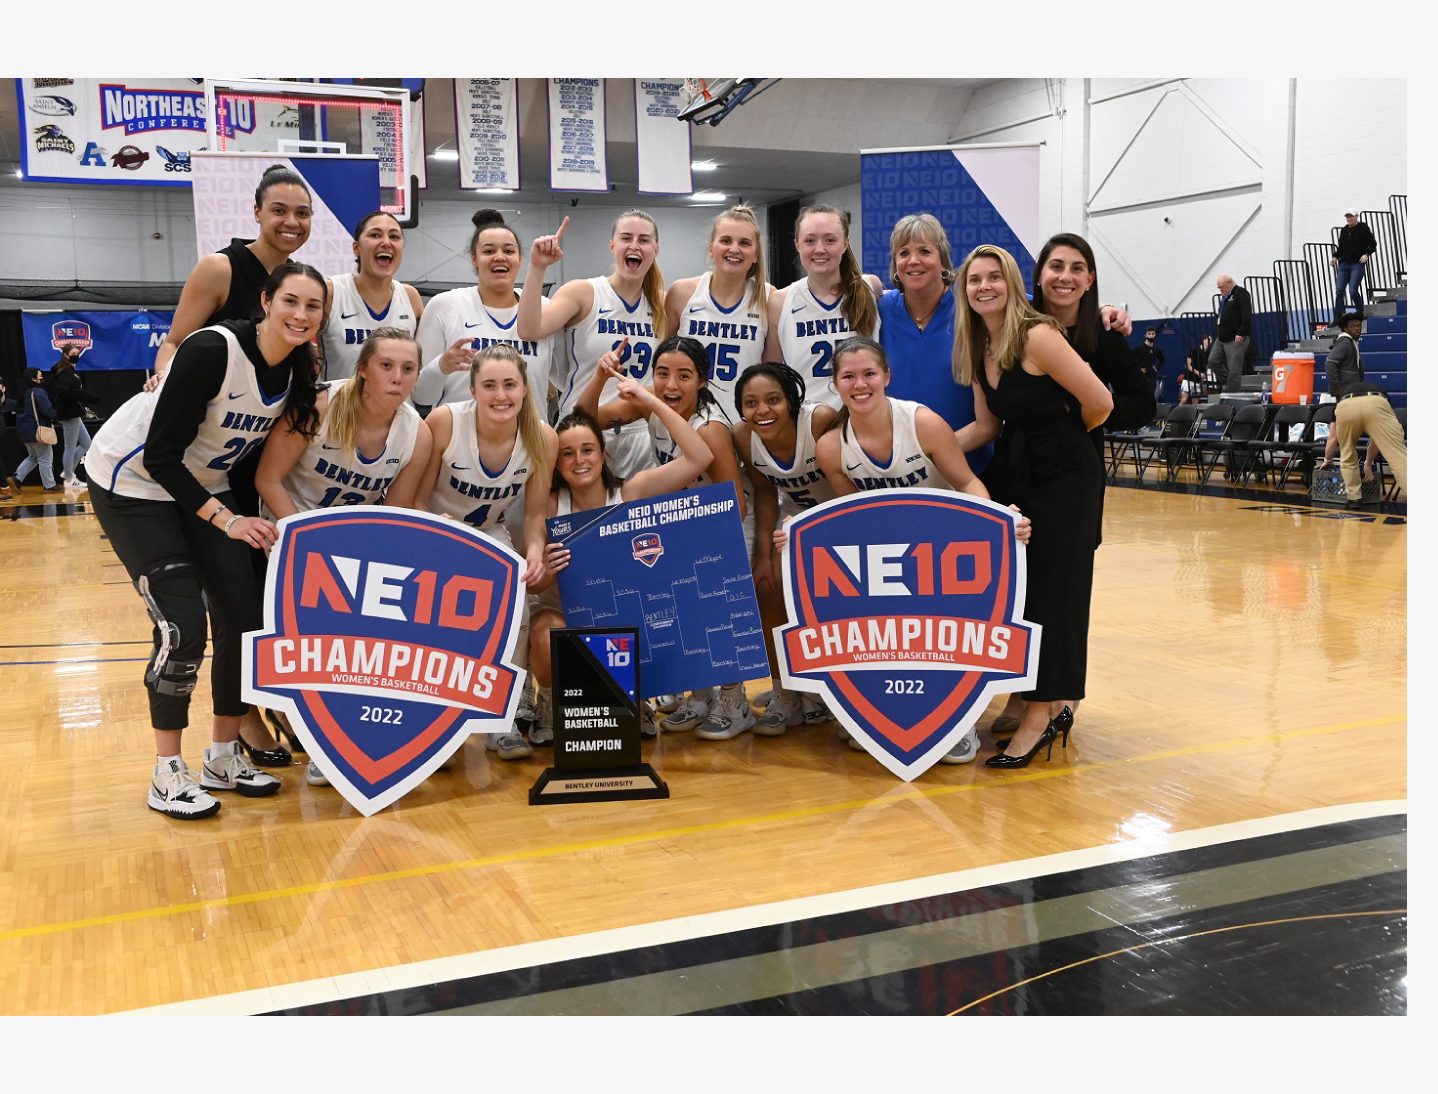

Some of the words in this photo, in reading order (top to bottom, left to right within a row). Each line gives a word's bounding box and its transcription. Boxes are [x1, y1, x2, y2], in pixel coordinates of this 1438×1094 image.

[553, 78, 599, 87] CHAMPIONS
[128, 118, 232, 136] CONFERECE
[57, 327, 86, 337] NE10
[689, 319, 758, 342] BENTLEY
[796, 317, 857, 338] BENTL
[611, 340, 652, 380] 23
[706, 343, 741, 382] 15
[314, 457, 394, 492] BENTLEY
[450, 474, 523, 499] BENTLEY
[463, 503, 493, 527] 4
[628, 505, 652, 520] NE10
[653, 494, 701, 514] WOMEN'S
[599, 514, 659, 537] BASKETBALL
[659, 499, 735, 526] CHAMPIONSHIP
[635, 538, 658, 548] NE10
[811, 540, 993, 599] NE10
[299, 551, 495, 632] NE10
[645, 605, 676, 623] BENTLEY
[606, 637, 630, 652] NE
[799, 618, 1012, 661] CHAMPIONS
[606, 651, 630, 667] 10
[853, 651, 897, 662] WOMEN'S
[897, 650, 956, 662] BASKETBALL
[273, 638, 498, 700] CHAMPIONS
[331, 673, 380, 687] WOMEN'S
[380, 677, 440, 696] BASKETBALL
[563, 689, 583, 698] 2022
[884, 679, 925, 695] 2022
[359, 705, 404, 725] 2022
[563, 706, 610, 719] WOMEN'S
[564, 718, 619, 730] BASKETBALL
[565, 739, 622, 753] CHAMPION
[565, 781, 594, 790] BENTLEY
[594, 779, 634, 789] UNIVERSITY
